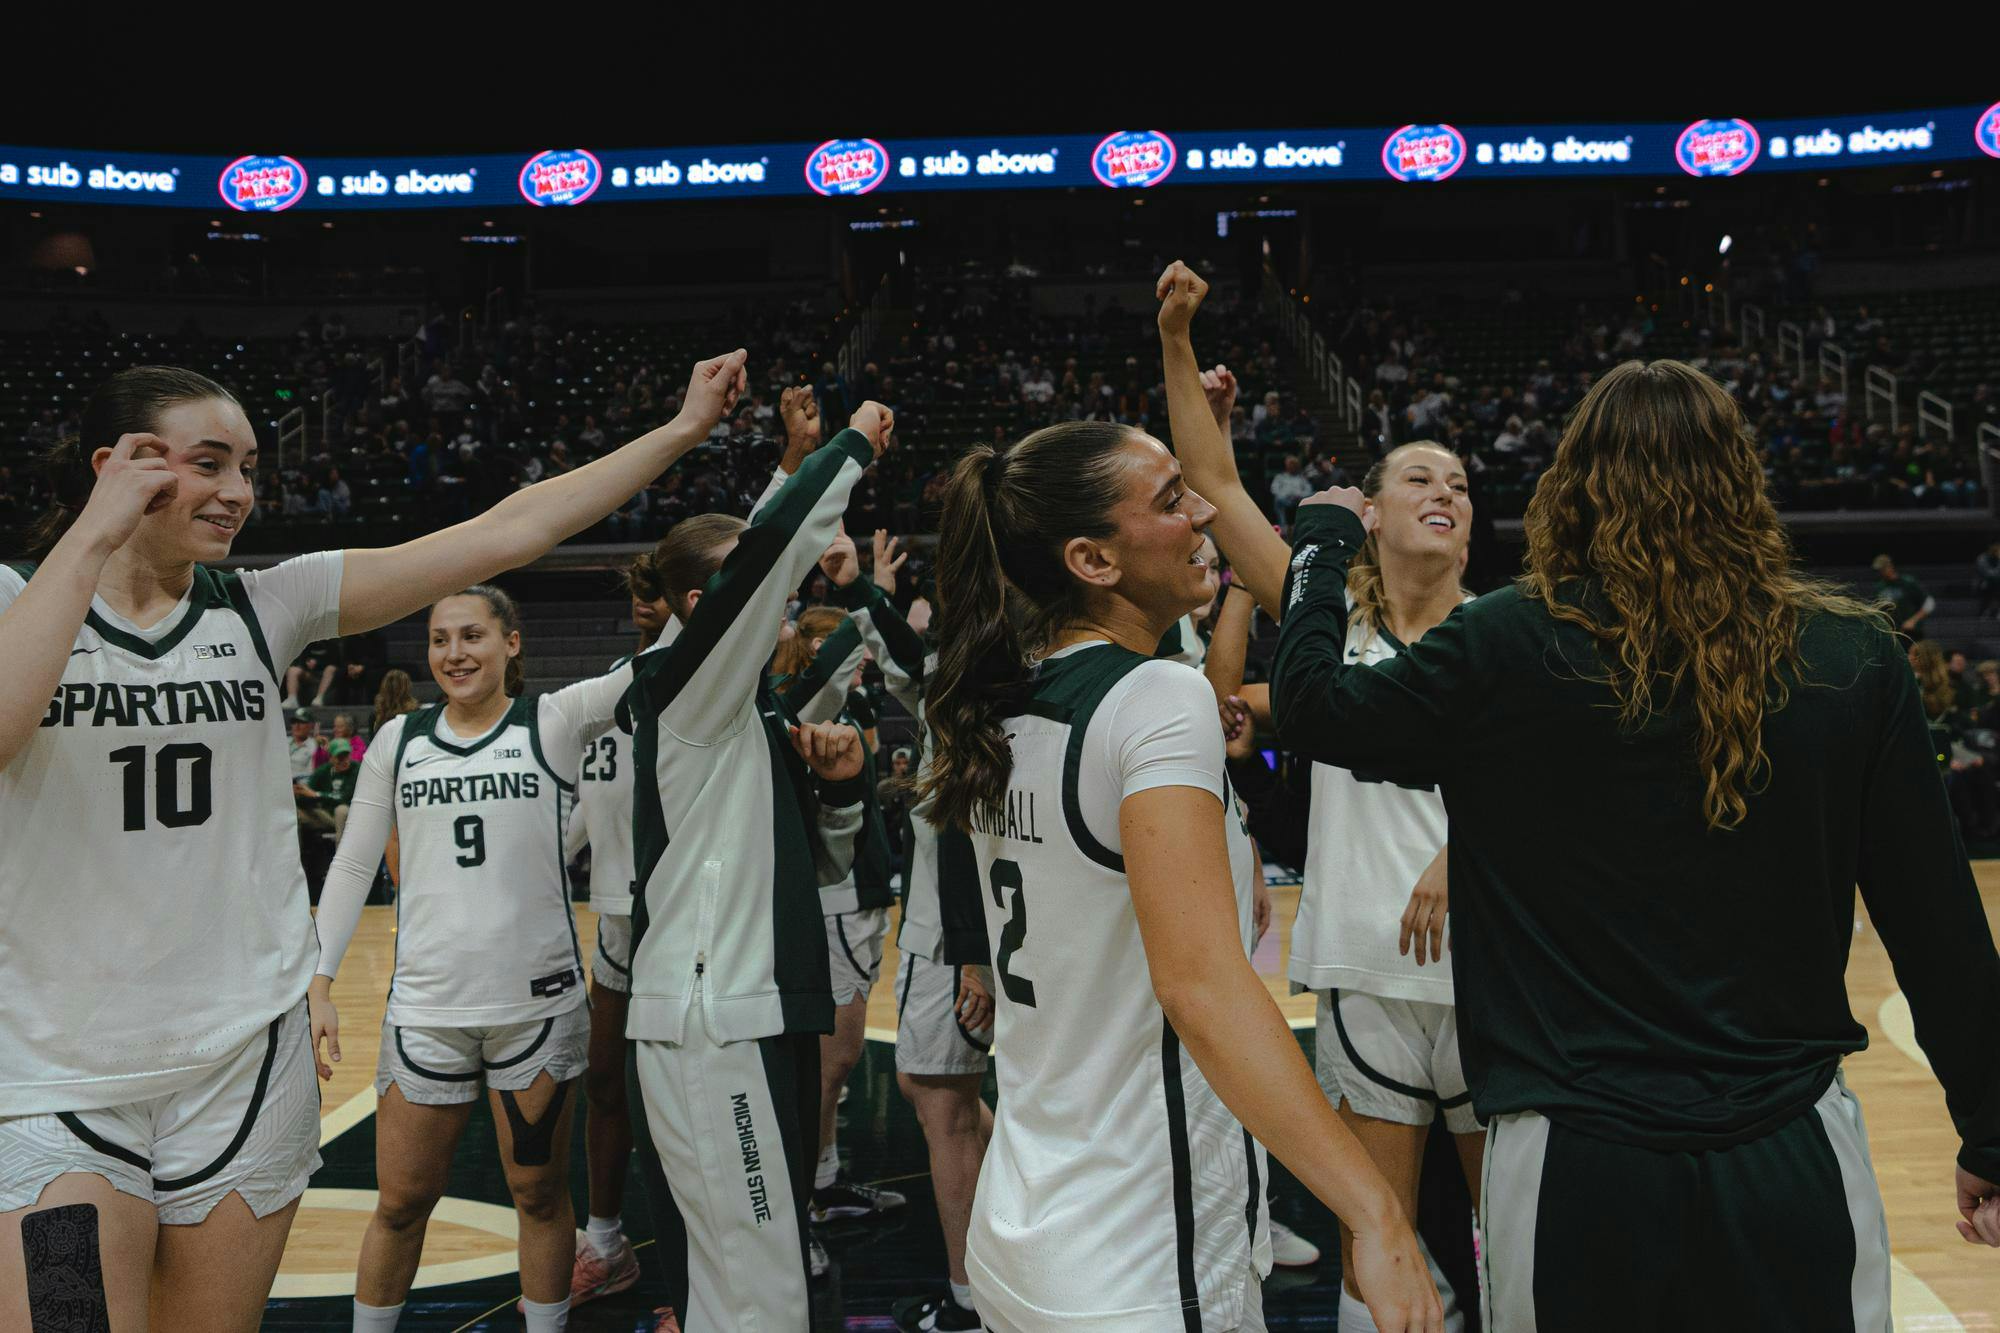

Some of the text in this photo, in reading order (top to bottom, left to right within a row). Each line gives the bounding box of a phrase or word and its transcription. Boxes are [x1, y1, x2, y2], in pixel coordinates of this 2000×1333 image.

[1187, 141, 1344, 168] a sub above
[1477, 136, 1632, 163] a sub above
[1770, 124, 1932, 156] a sub above
[0, 163, 177, 192] a sub above
[612, 157, 768, 186] a sub above
[900, 148, 1057, 176] a sub above
[318, 168, 475, 195] a sub above
[39, 680, 264, 727] SPARTANS
[582, 736, 617, 781] 23
[109, 742, 212, 831] 10
[400, 772, 539, 808] SPARTANS
[453, 815, 486, 868] 9
[990, 858, 1037, 1009] 2
[730, 1092, 771, 1226] MICHIGAN STATE
